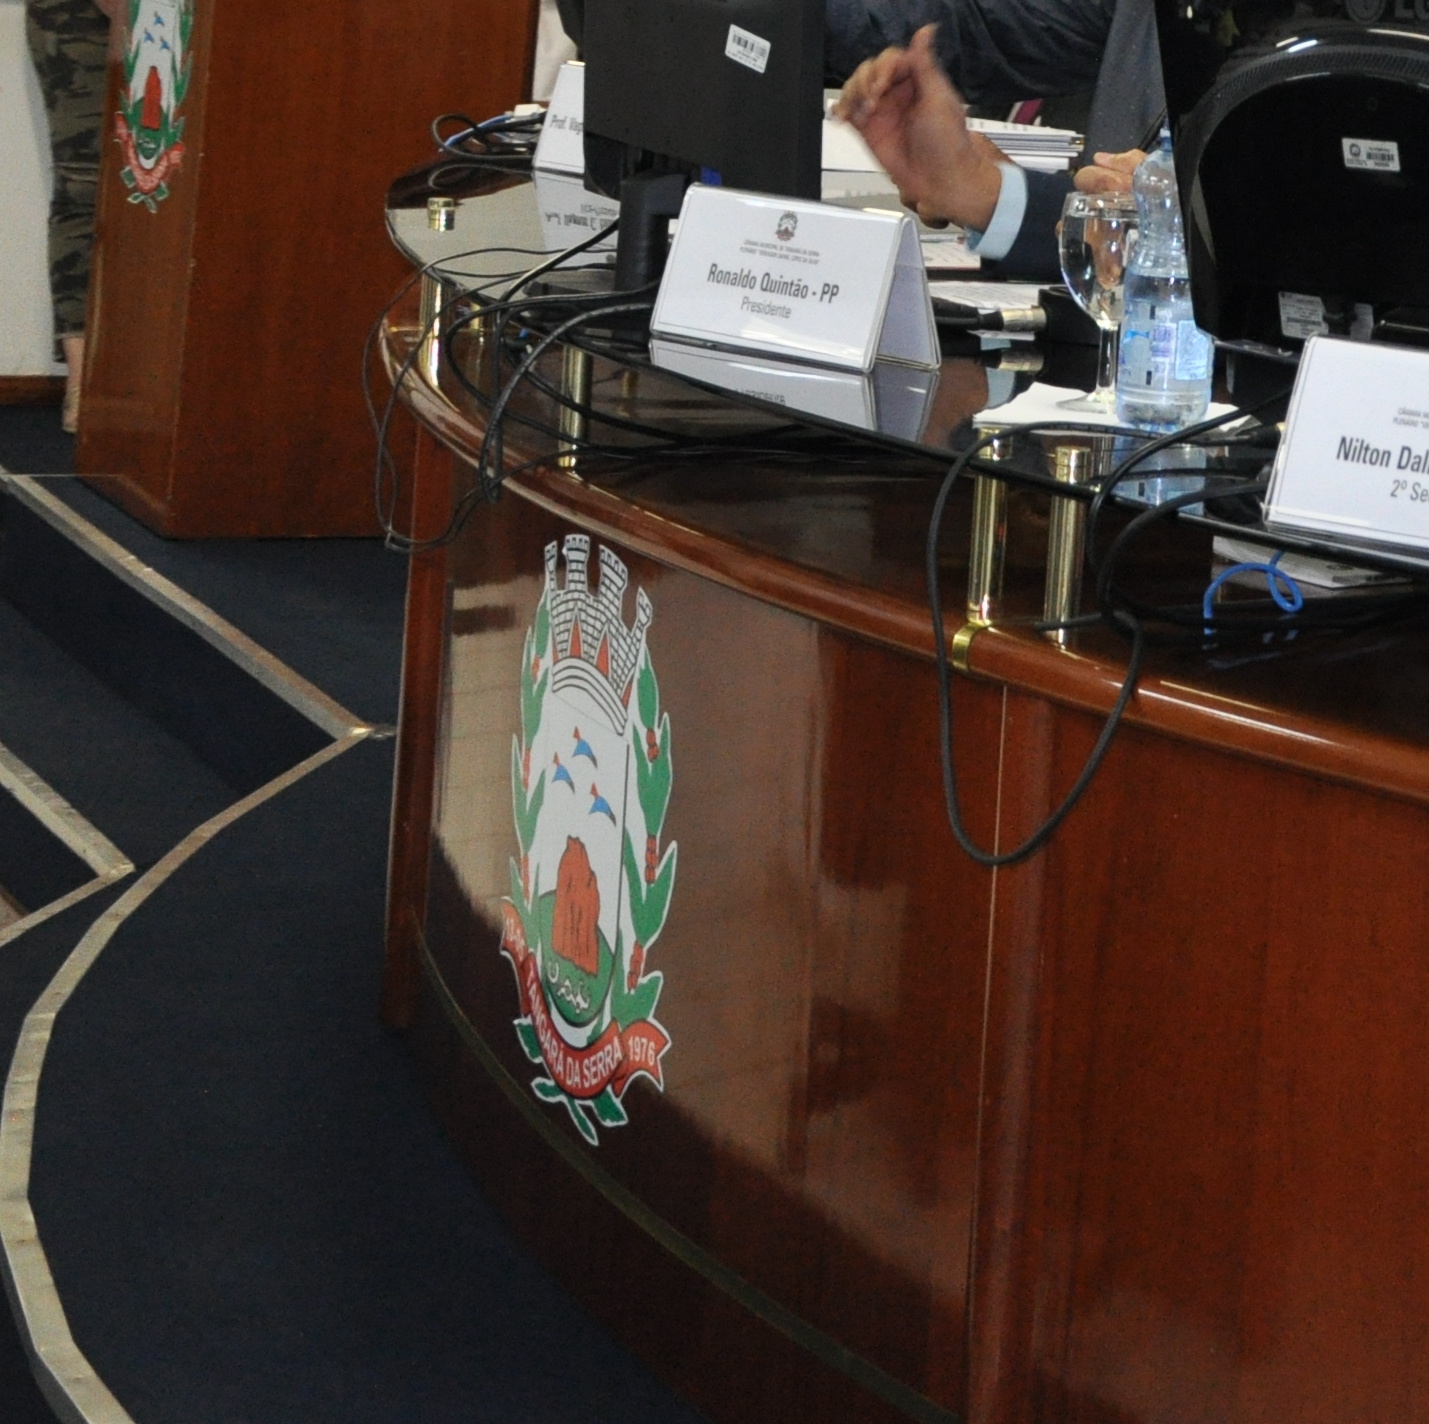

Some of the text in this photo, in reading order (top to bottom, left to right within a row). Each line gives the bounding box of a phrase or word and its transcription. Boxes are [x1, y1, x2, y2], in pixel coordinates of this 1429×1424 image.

[707, 263, 757, 289] Ronaldo
[760, 272, 808, 299] Quintão
[819, 282, 840, 304] PP
[740, 296, 792, 319] Presidente
[1336, 436, 1391, 469] Nilton
[1391, 479, 1407, 498] 2º
[565, 1057, 581, 1089] DA
[583, 1036, 623, 1088] SERRA
[628, 1035, 655, 1066] 1976
